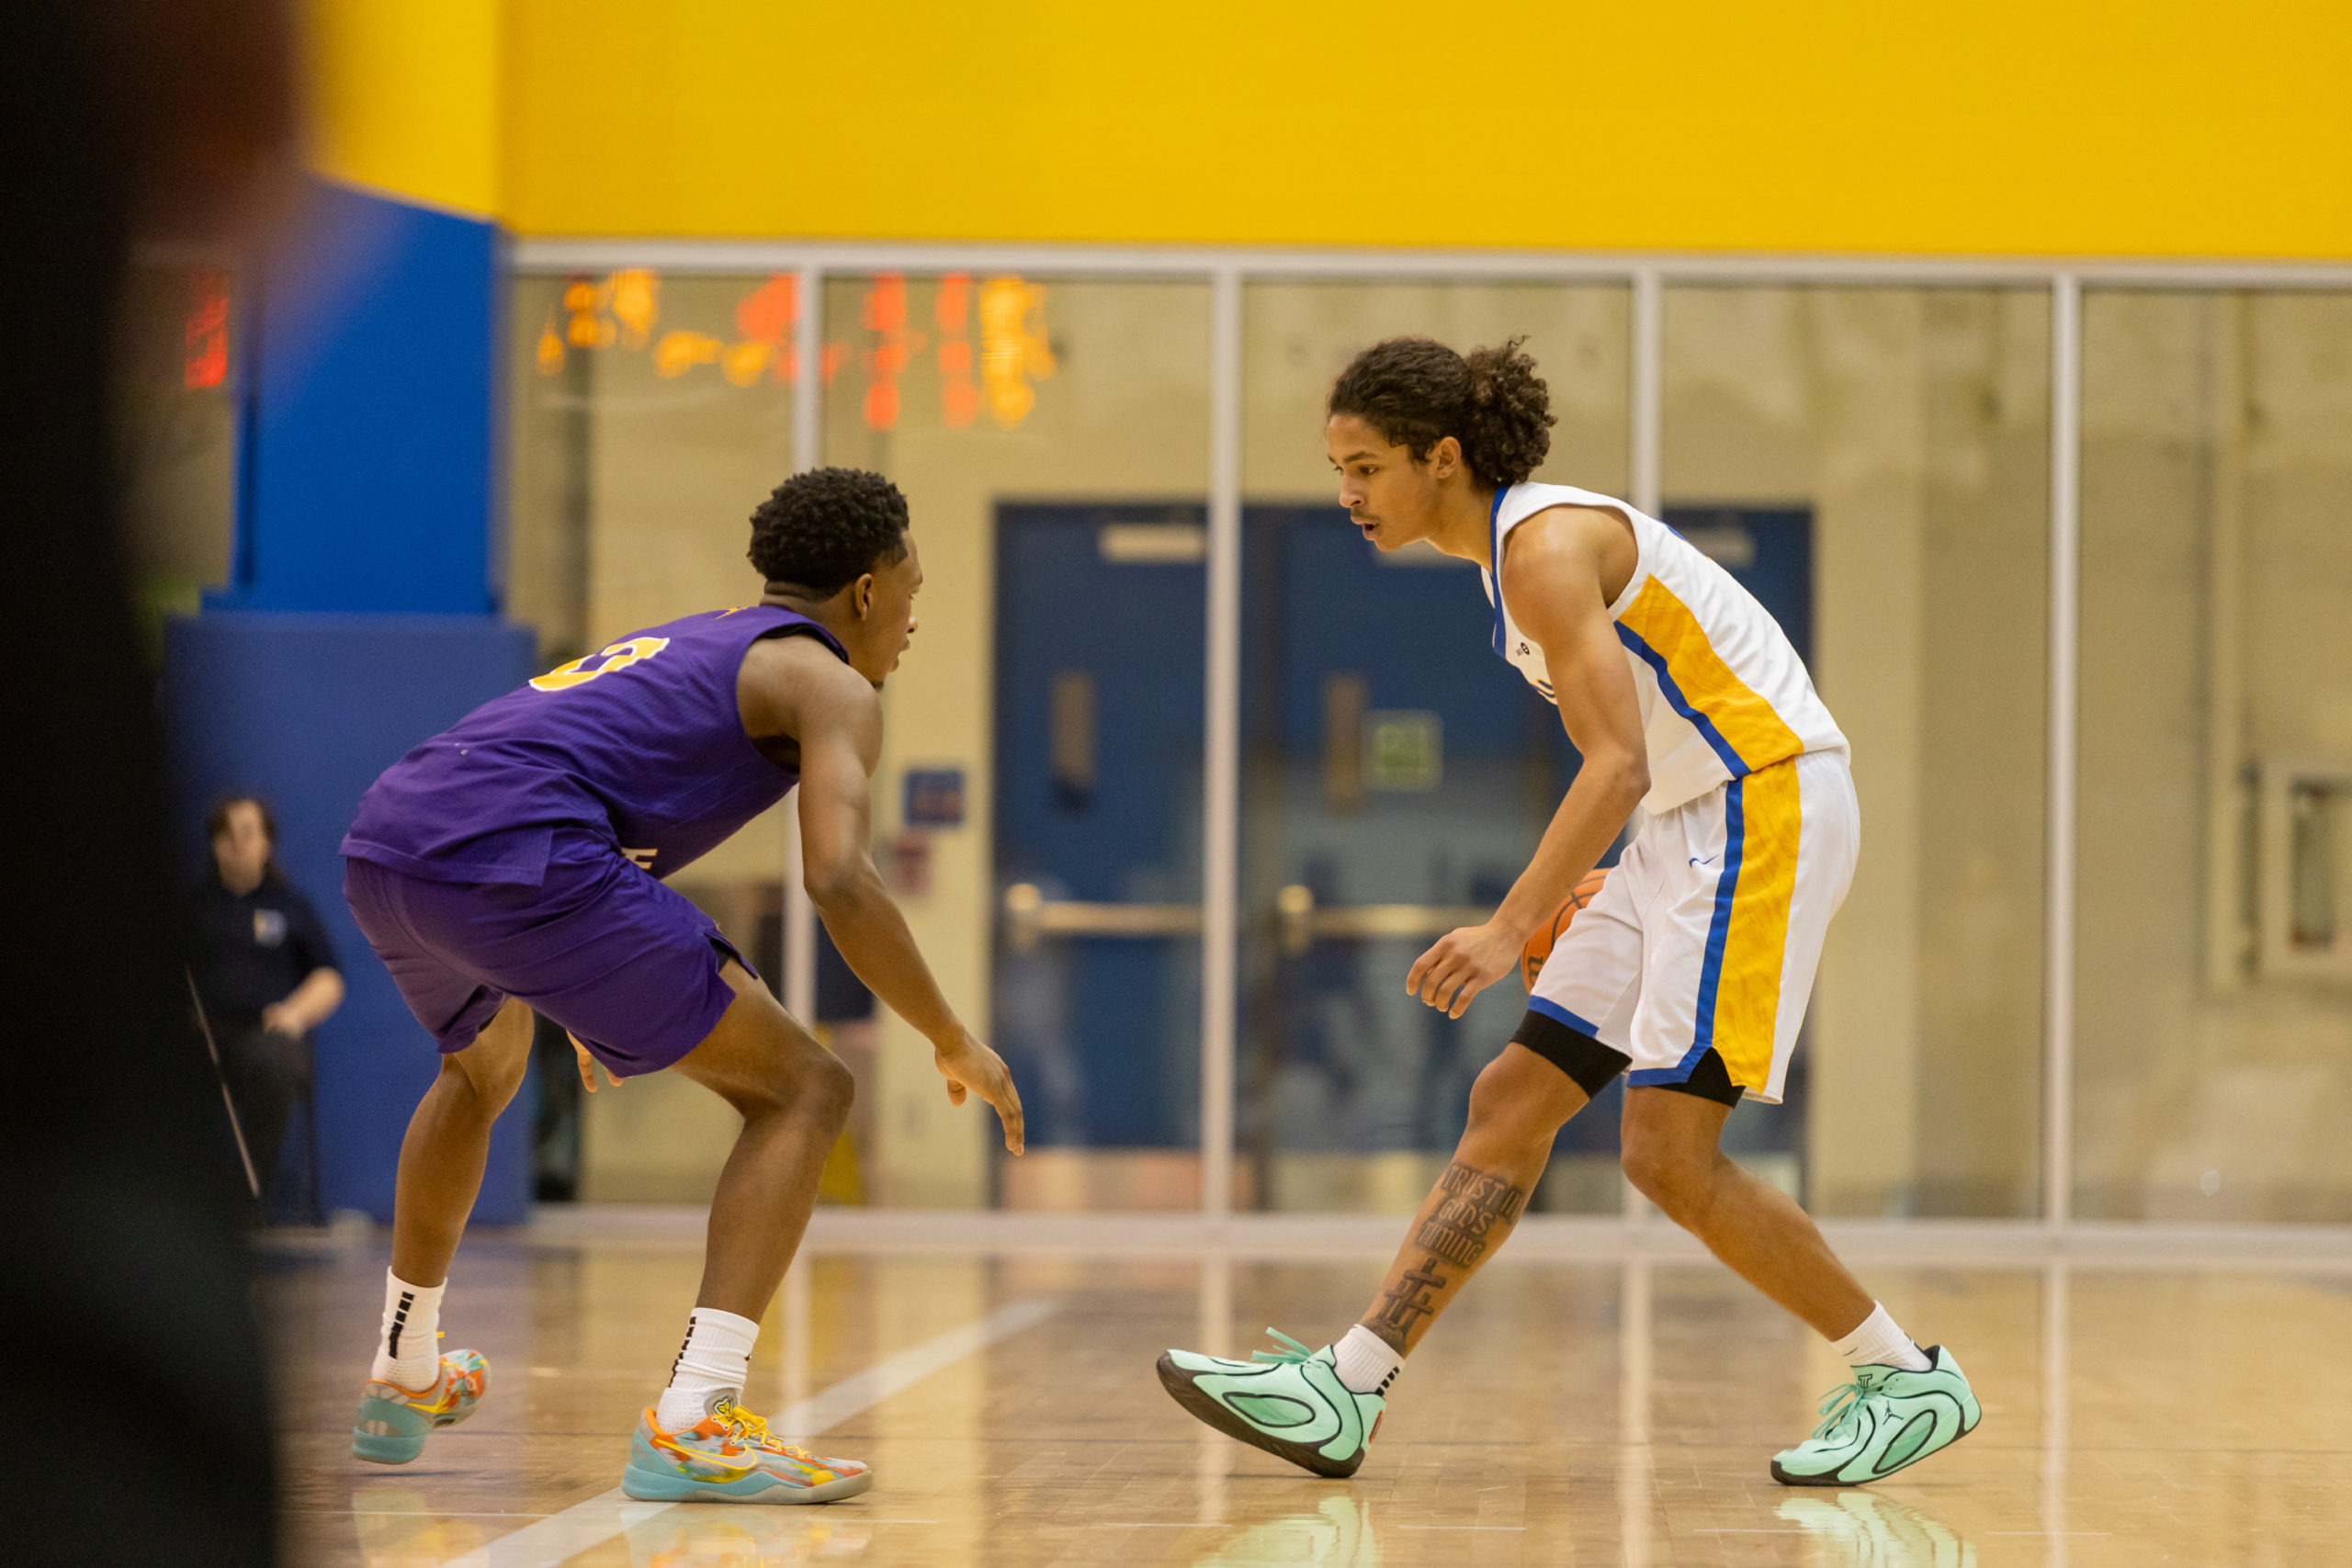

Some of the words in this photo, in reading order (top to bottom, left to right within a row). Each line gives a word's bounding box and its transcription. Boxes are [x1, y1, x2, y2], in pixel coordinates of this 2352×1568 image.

[1442, 1165, 1507, 1205] TRUST
[1438, 1198, 1495, 1235] GOD'S
[1418, 1221, 1484, 1266] TIMING
